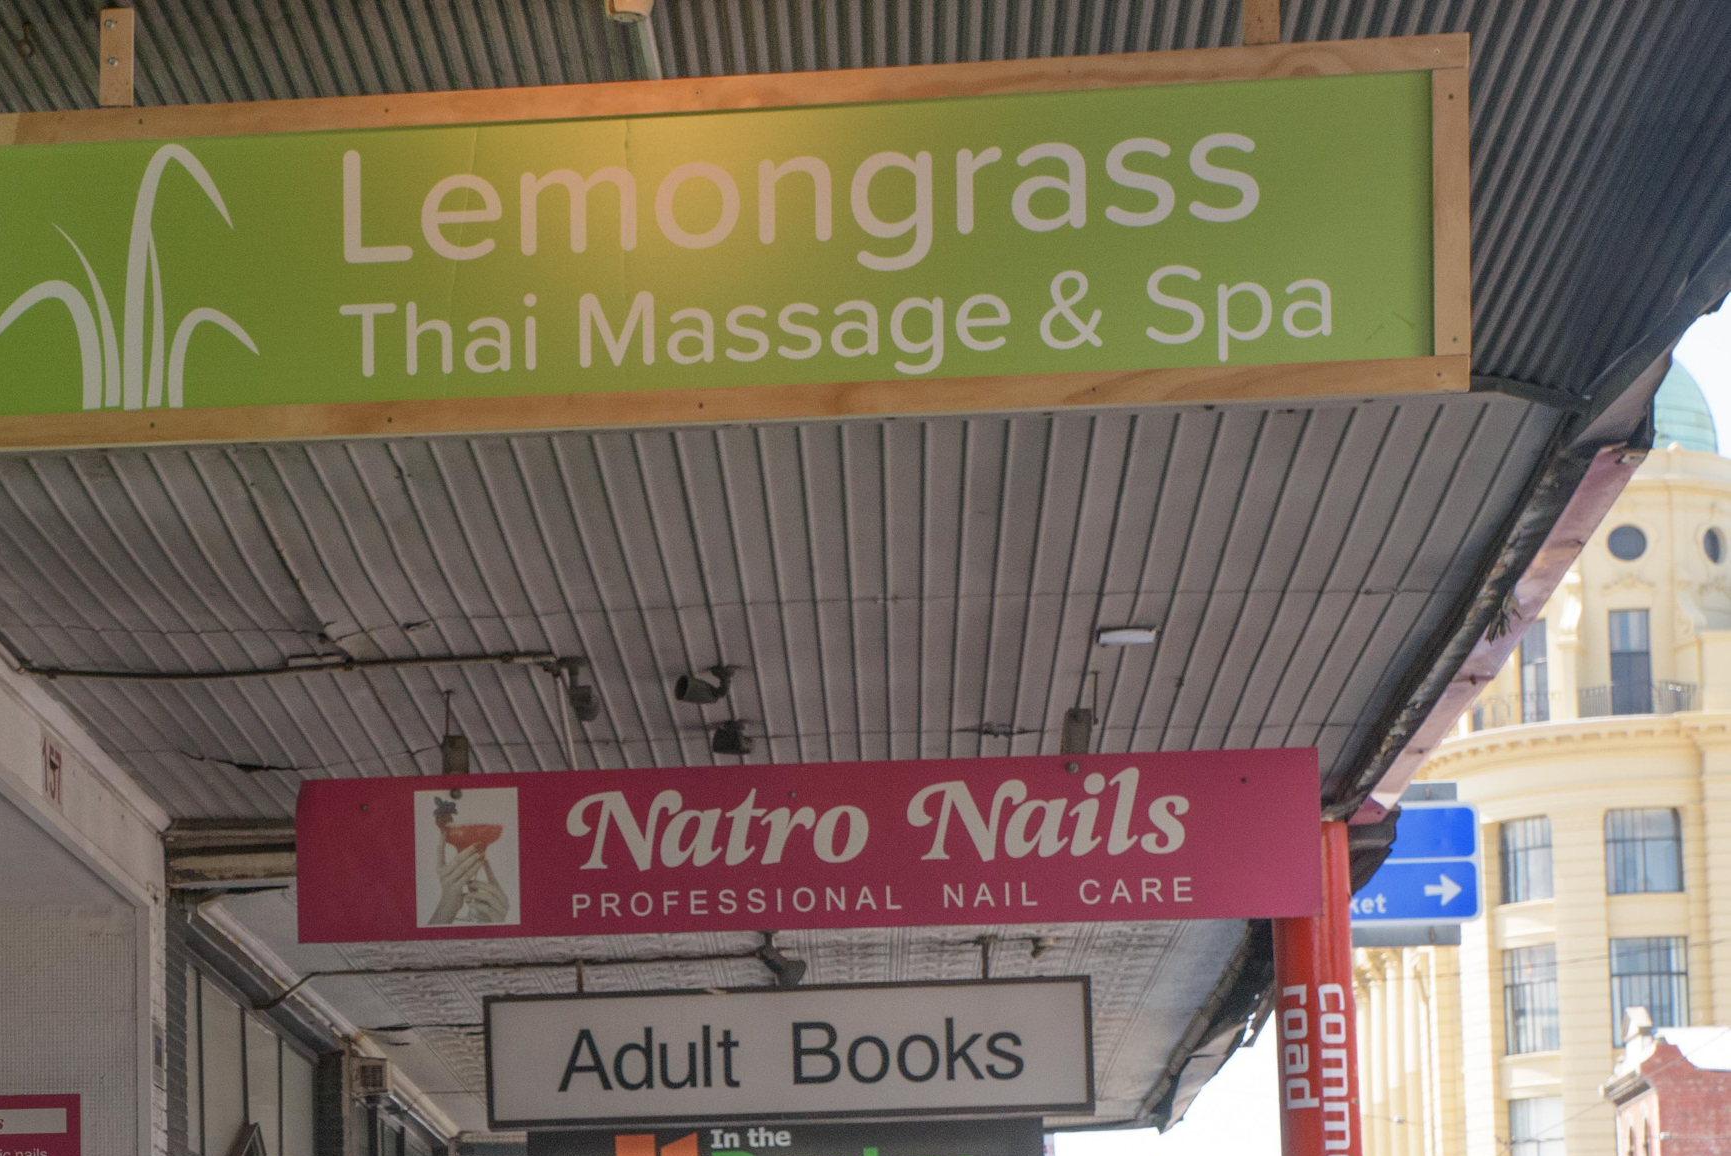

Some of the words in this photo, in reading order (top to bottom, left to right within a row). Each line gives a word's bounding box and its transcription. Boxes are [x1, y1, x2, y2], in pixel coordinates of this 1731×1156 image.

[343, 132, 1261, 274] Lemongrass
[340, 299, 538, 378] Thai
[578, 290, 1010, 375] Massage
[1039, 270, 1104, 349] &
[1147, 265, 1334, 361] Spa
[565, 787, 868, 870] Natro
[906, 766, 1188, 861] Nails
[571, 887, 902, 918] PROFESSIONAL
[943, 880, 1037, 907] NAIL
[1079, 876, 1193, 905] CARE
[559, 1026, 741, 1093] Adult
[792, 1017, 1023, 1083] Books
[1282, 984, 1320, 1109] road
[710, 1129, 741, 1149] In
[748, 1127, 791, 1149] the
